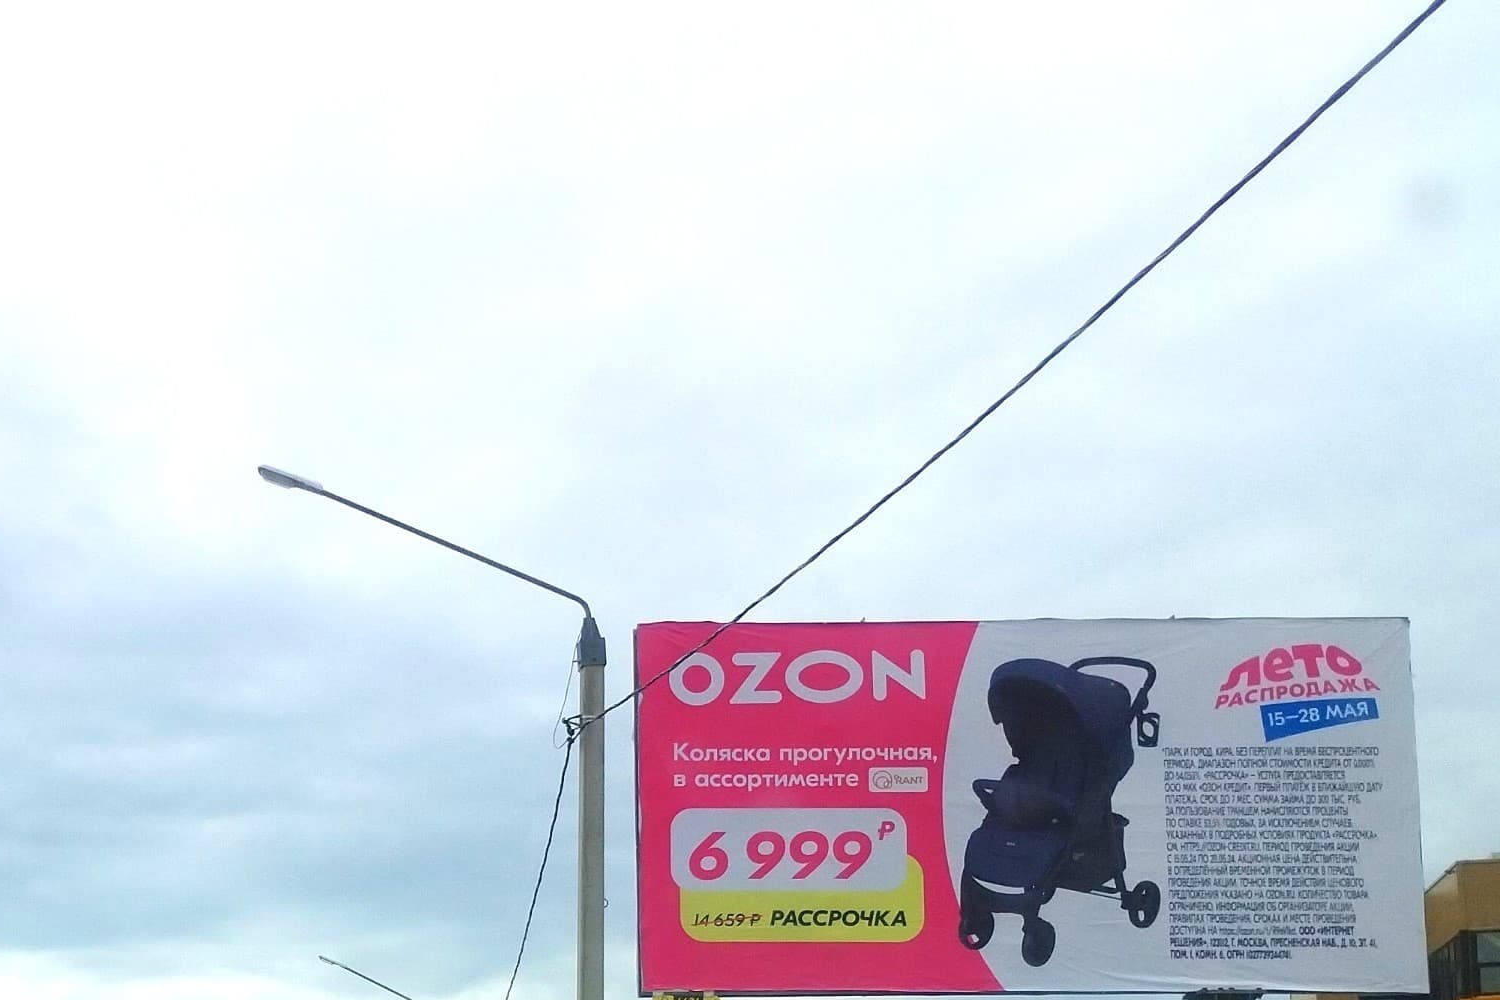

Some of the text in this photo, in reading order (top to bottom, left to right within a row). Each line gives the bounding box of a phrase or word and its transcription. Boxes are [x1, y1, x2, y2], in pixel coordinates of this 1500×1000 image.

[668, 650, 926, 706] OZON
[1215, 677, 1381, 709] РАСПРОДАЖА
[1326, 701, 1369, 720] МАЯ
[673, 743, 938, 766] Коляска прогулочная,
[1343, 759, 1352, 768] ОТ
[673, 772, 859, 791] в ассортименте
[894, 775, 924, 785] RANT
[689, 831, 729, 881] 6
[746, 830, 872, 880] 999
[714, 913, 745, 926] 659
[770, 910, 907, 927] РАССРОЧКА
[1299, 926, 1315, 935] ООО
[1270, 938, 1320, 948] ПРЕСНЕНСКАЯ
[1227, 950, 1245, 959] ОГРН
